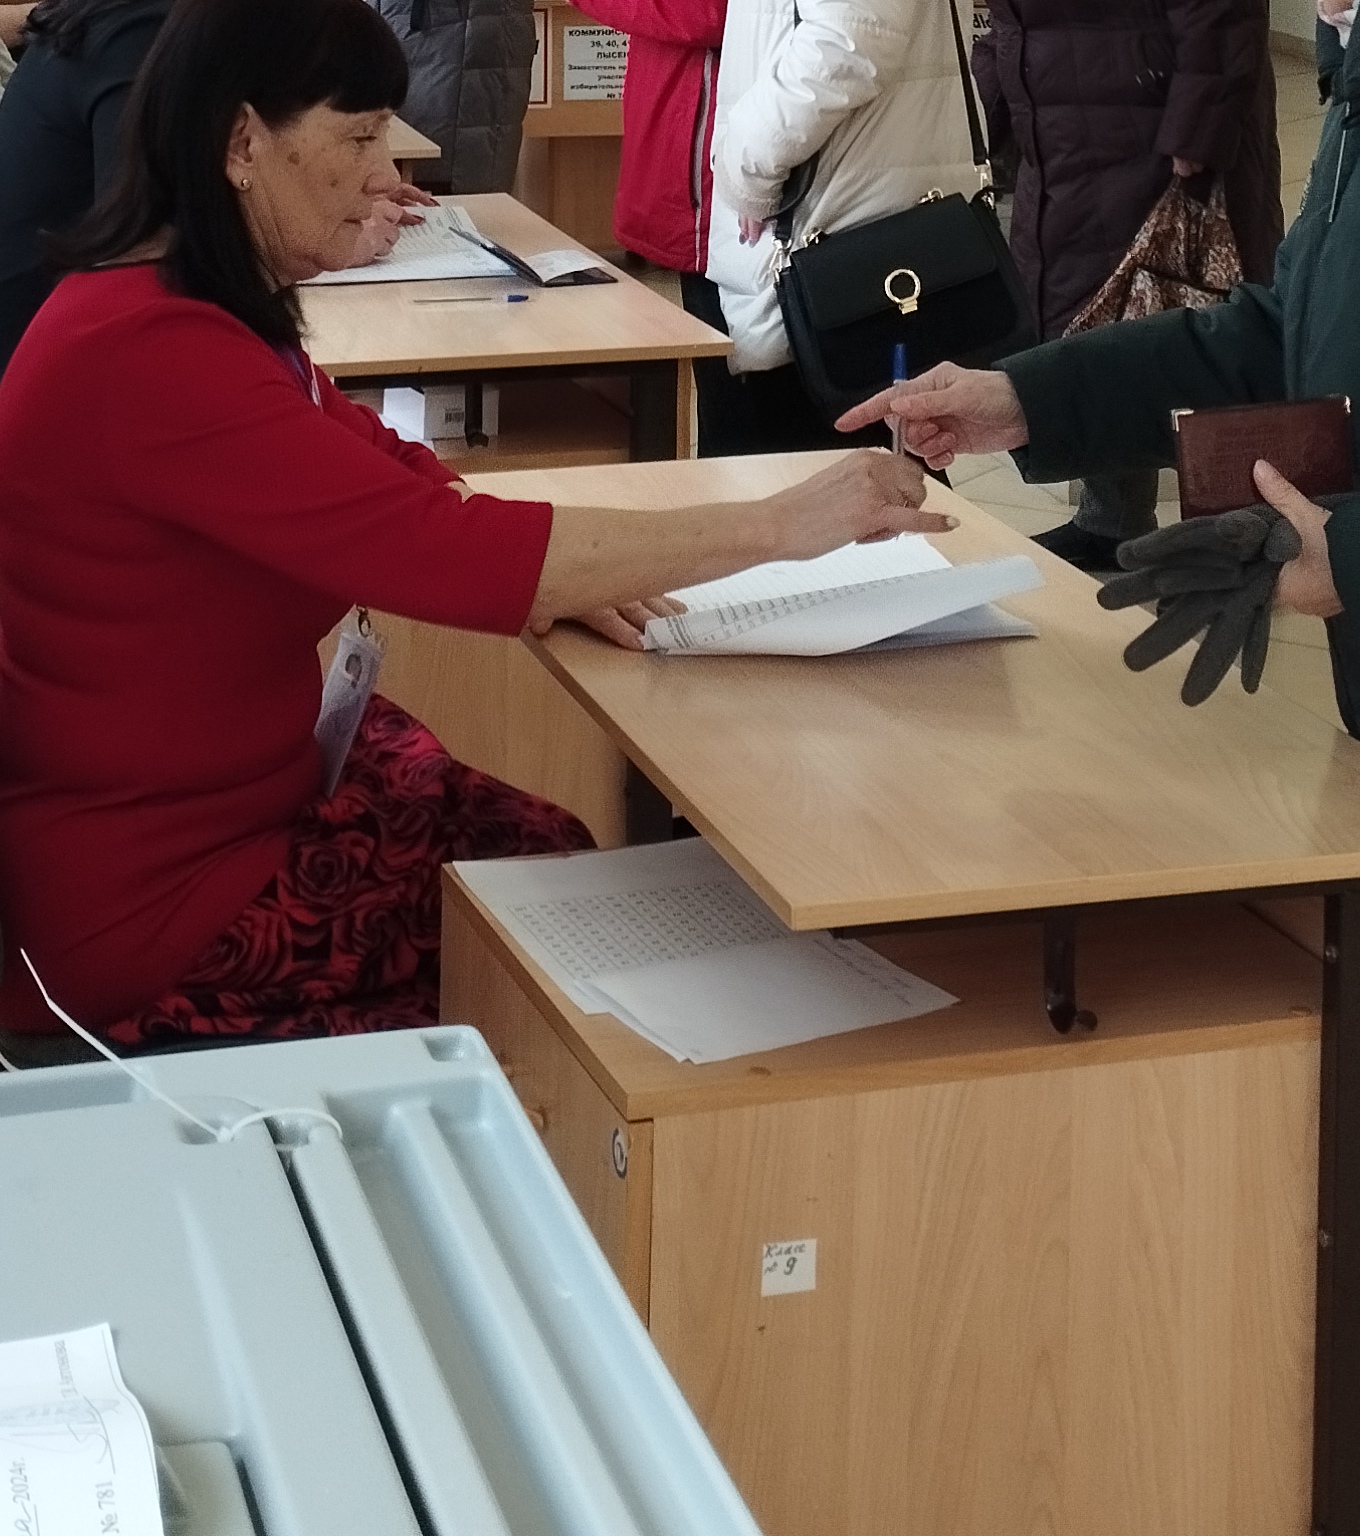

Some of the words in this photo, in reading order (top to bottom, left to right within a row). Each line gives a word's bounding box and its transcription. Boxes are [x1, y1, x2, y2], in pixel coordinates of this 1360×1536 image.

[568, 29, 629, 37] КОММУНИС
[95, 1480, 116, 1508] 781
[101, 1513, 120, 1534] №
